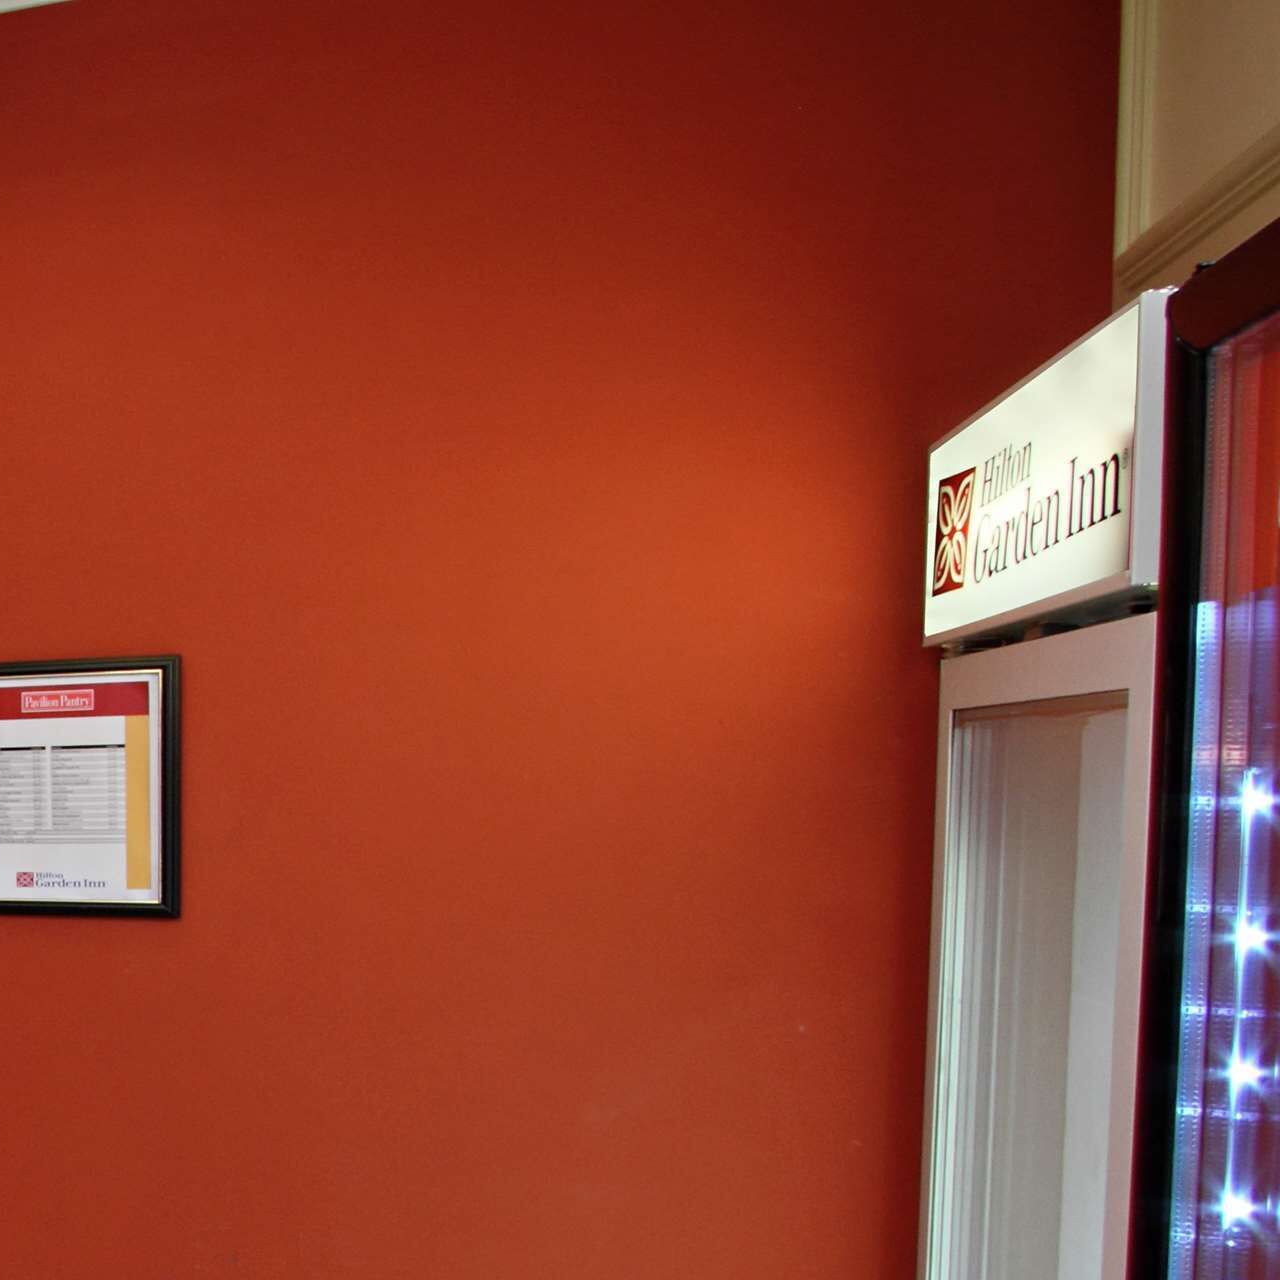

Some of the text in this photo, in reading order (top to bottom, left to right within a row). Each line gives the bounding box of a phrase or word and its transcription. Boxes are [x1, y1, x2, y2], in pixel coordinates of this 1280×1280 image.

[979, 441, 1033, 508] Hilton
[972, 451, 1122, 584] Garden Inn
[24, 694, 90, 709] Pavilion Pantry
[35, 878, 106, 888] Garden Inn
